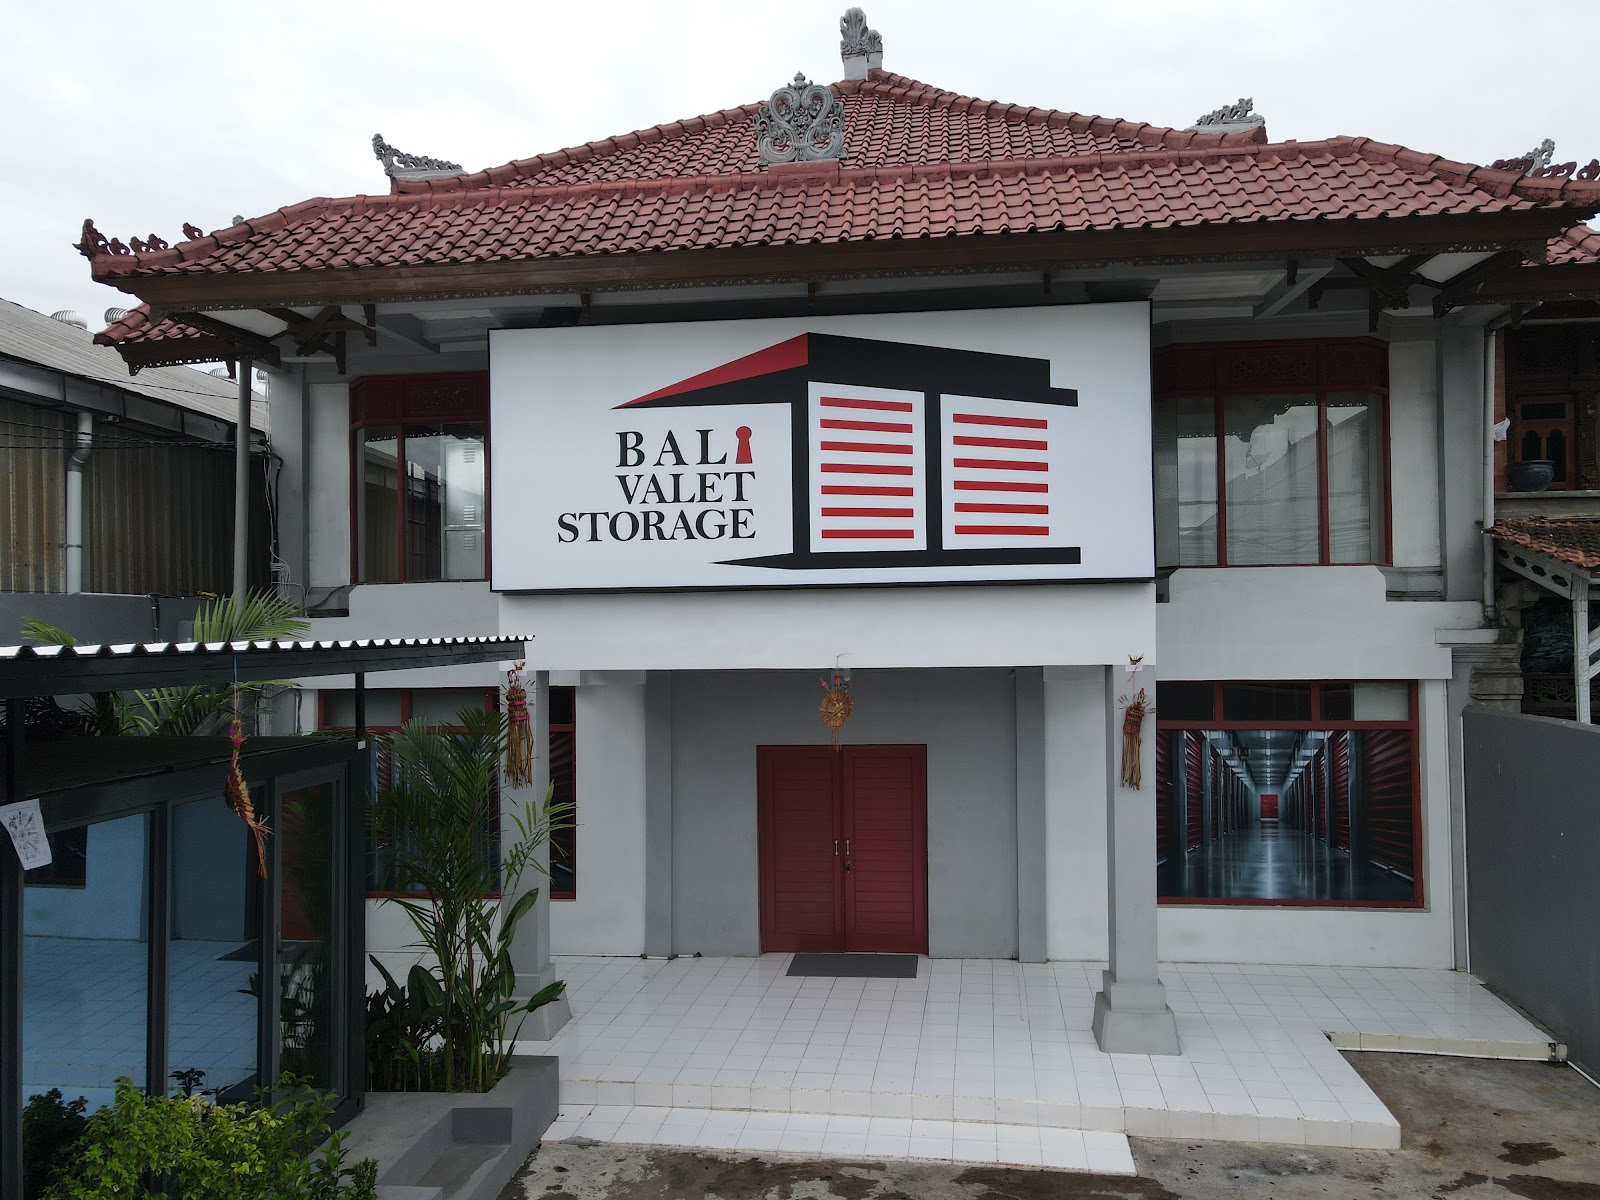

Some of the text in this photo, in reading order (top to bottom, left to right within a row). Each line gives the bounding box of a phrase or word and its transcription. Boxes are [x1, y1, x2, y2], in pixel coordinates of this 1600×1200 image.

[615, 426, 753, 467] BALI
[614, 471, 756, 505] VALET
[557, 508, 757, 543] STORAGE
